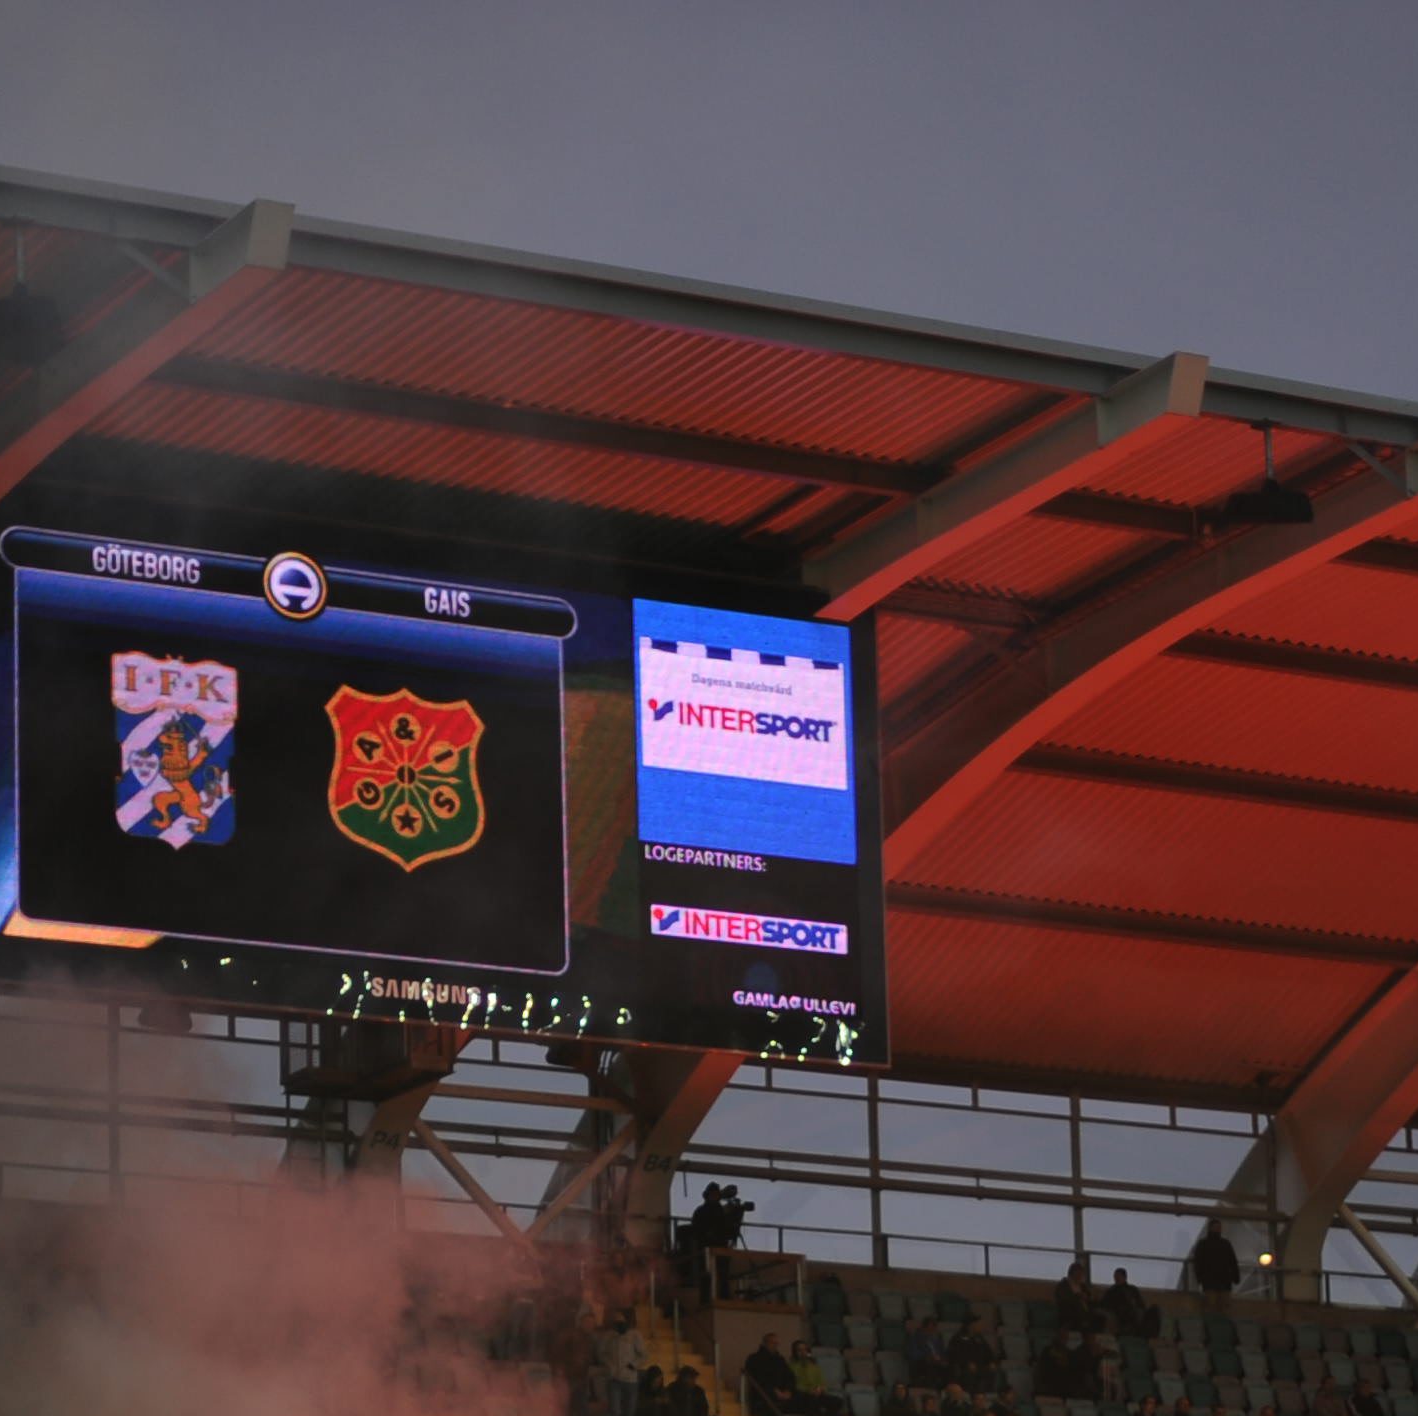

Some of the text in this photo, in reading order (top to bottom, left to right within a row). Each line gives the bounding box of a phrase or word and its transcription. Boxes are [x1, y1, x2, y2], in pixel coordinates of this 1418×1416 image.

[92, 543, 201, 584] GÖTEBORG
[424, 586, 470, 618] GAIS
[678, 701, 833, 742] INTERSPORT
[644, 844, 767, 872] LOGEPARTNERS:
[684, 909, 841, 950] INTERSPORT
[733, 990, 857, 1016] GAMLA ULLEVI
